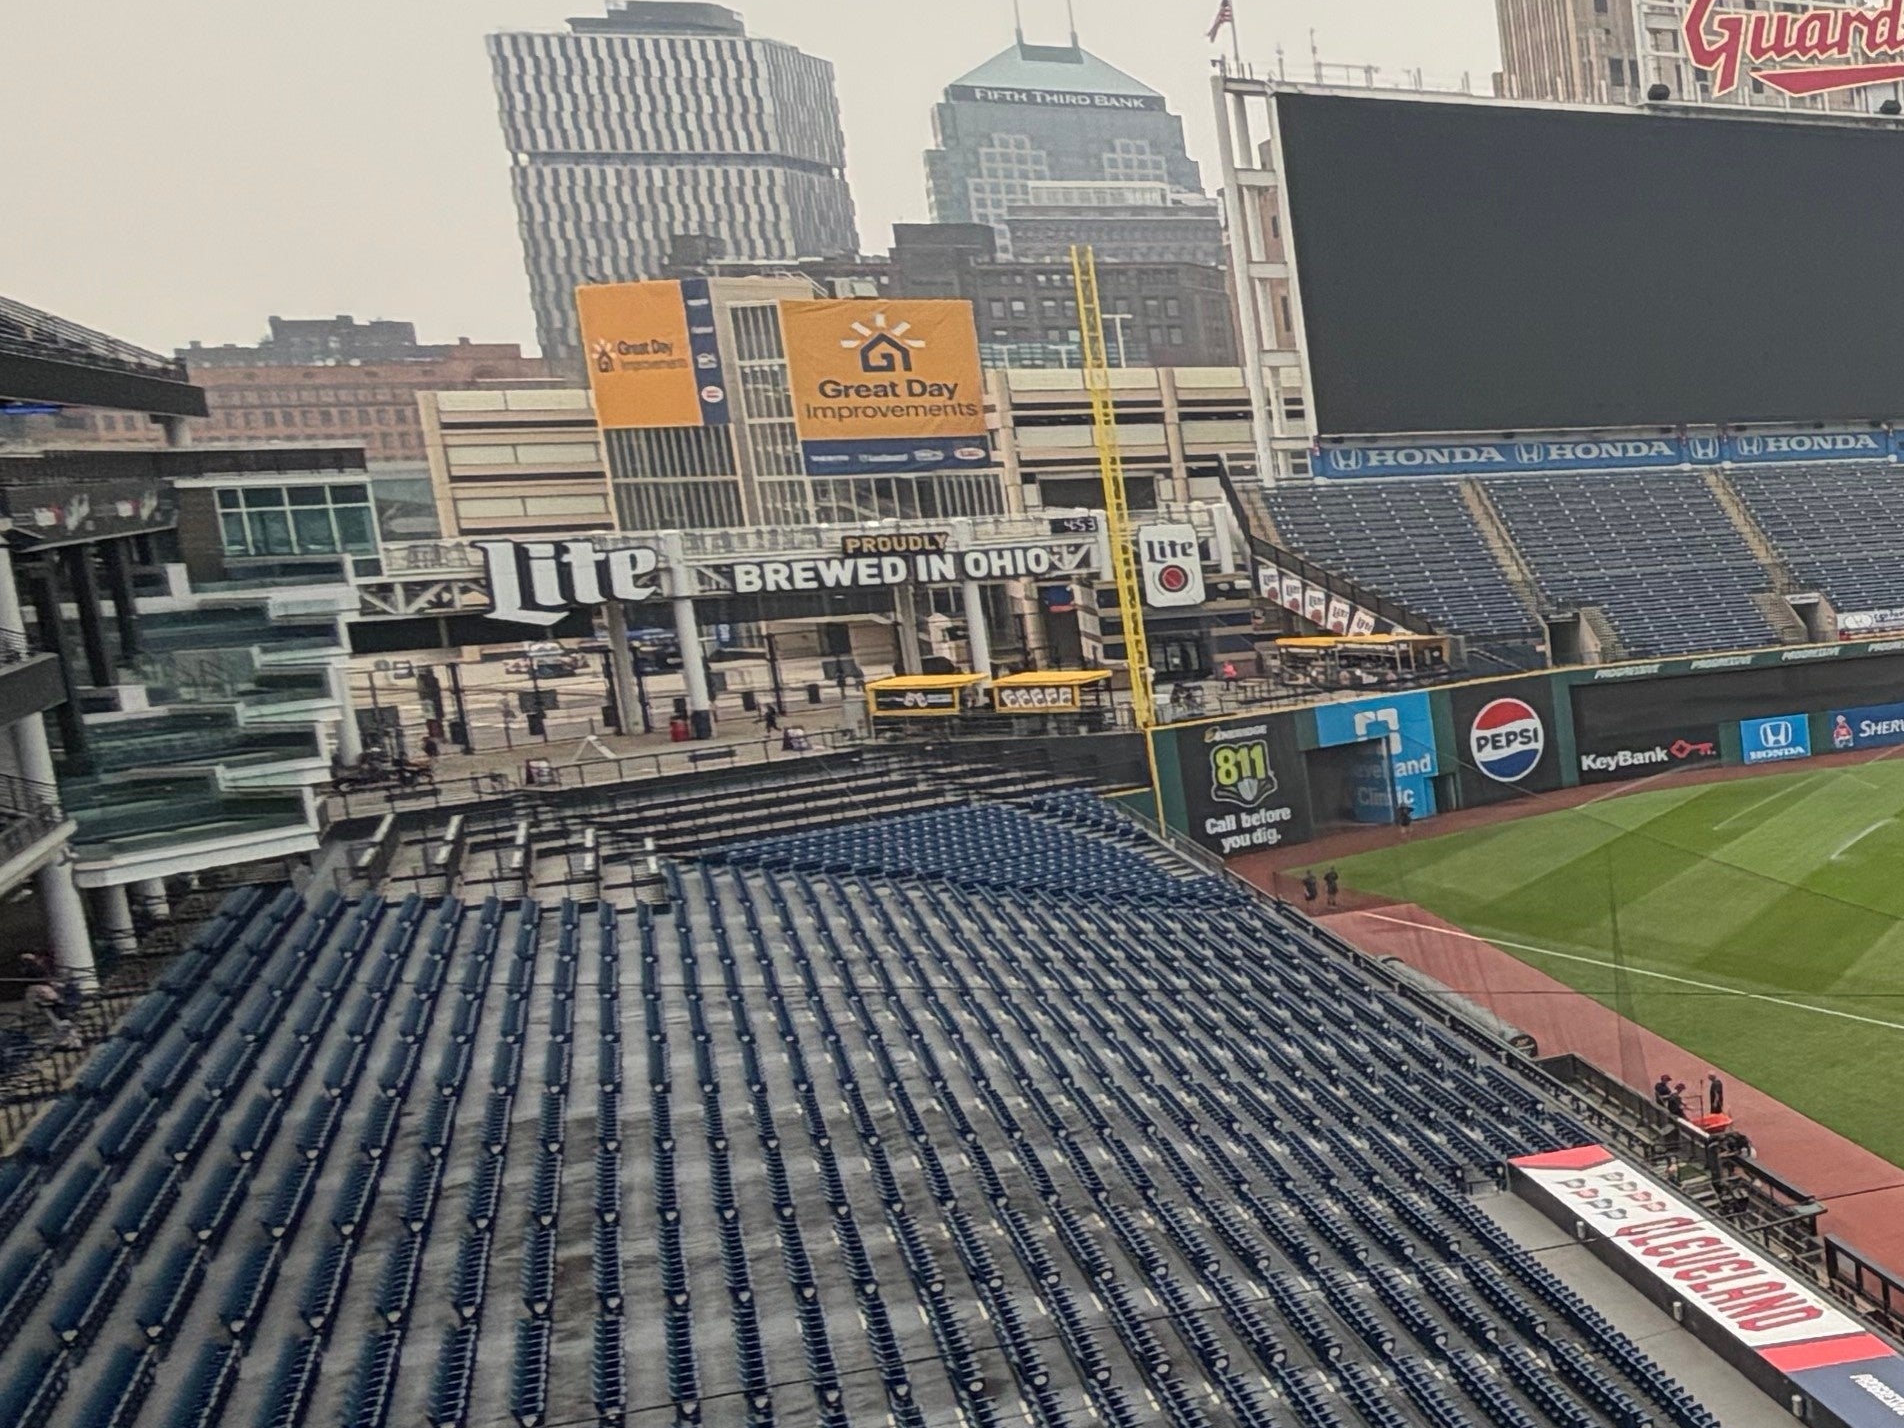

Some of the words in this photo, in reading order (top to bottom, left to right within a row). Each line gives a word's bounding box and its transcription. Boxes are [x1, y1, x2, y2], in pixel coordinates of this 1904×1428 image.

[818, 379, 900, 399] Great
[906, 378, 959, 400] Day
[805, 402, 978, 422] Improvements
[1369, 446, 1506, 467] HONDA
[1547, 442, 1673, 460] HONDA
[1761, 436, 1878, 452] HONDA
[846, 532, 949, 554] PROUDLY
[1145, 537, 1195, 565] Lite
[473, 539, 660, 626] Lite
[735, 556, 903, 595] BREWED
[916, 553, 956, 582] IN
[964, 544, 1050, 579] OHIO
[1475, 727, 1540, 753] PEPSI
[1749, 745, 1805, 761] HONDA
[1214, 744, 1266, 786] 811
[1581, 746, 1668, 772] KeyBank
[1205, 816, 1237, 835] Call
[1241, 807, 1292, 828] before
[1221, 833, 1251, 854] you
[1252, 826, 1282, 846] dig.
[1615, 1216, 1824, 1332] CLEVELAND
